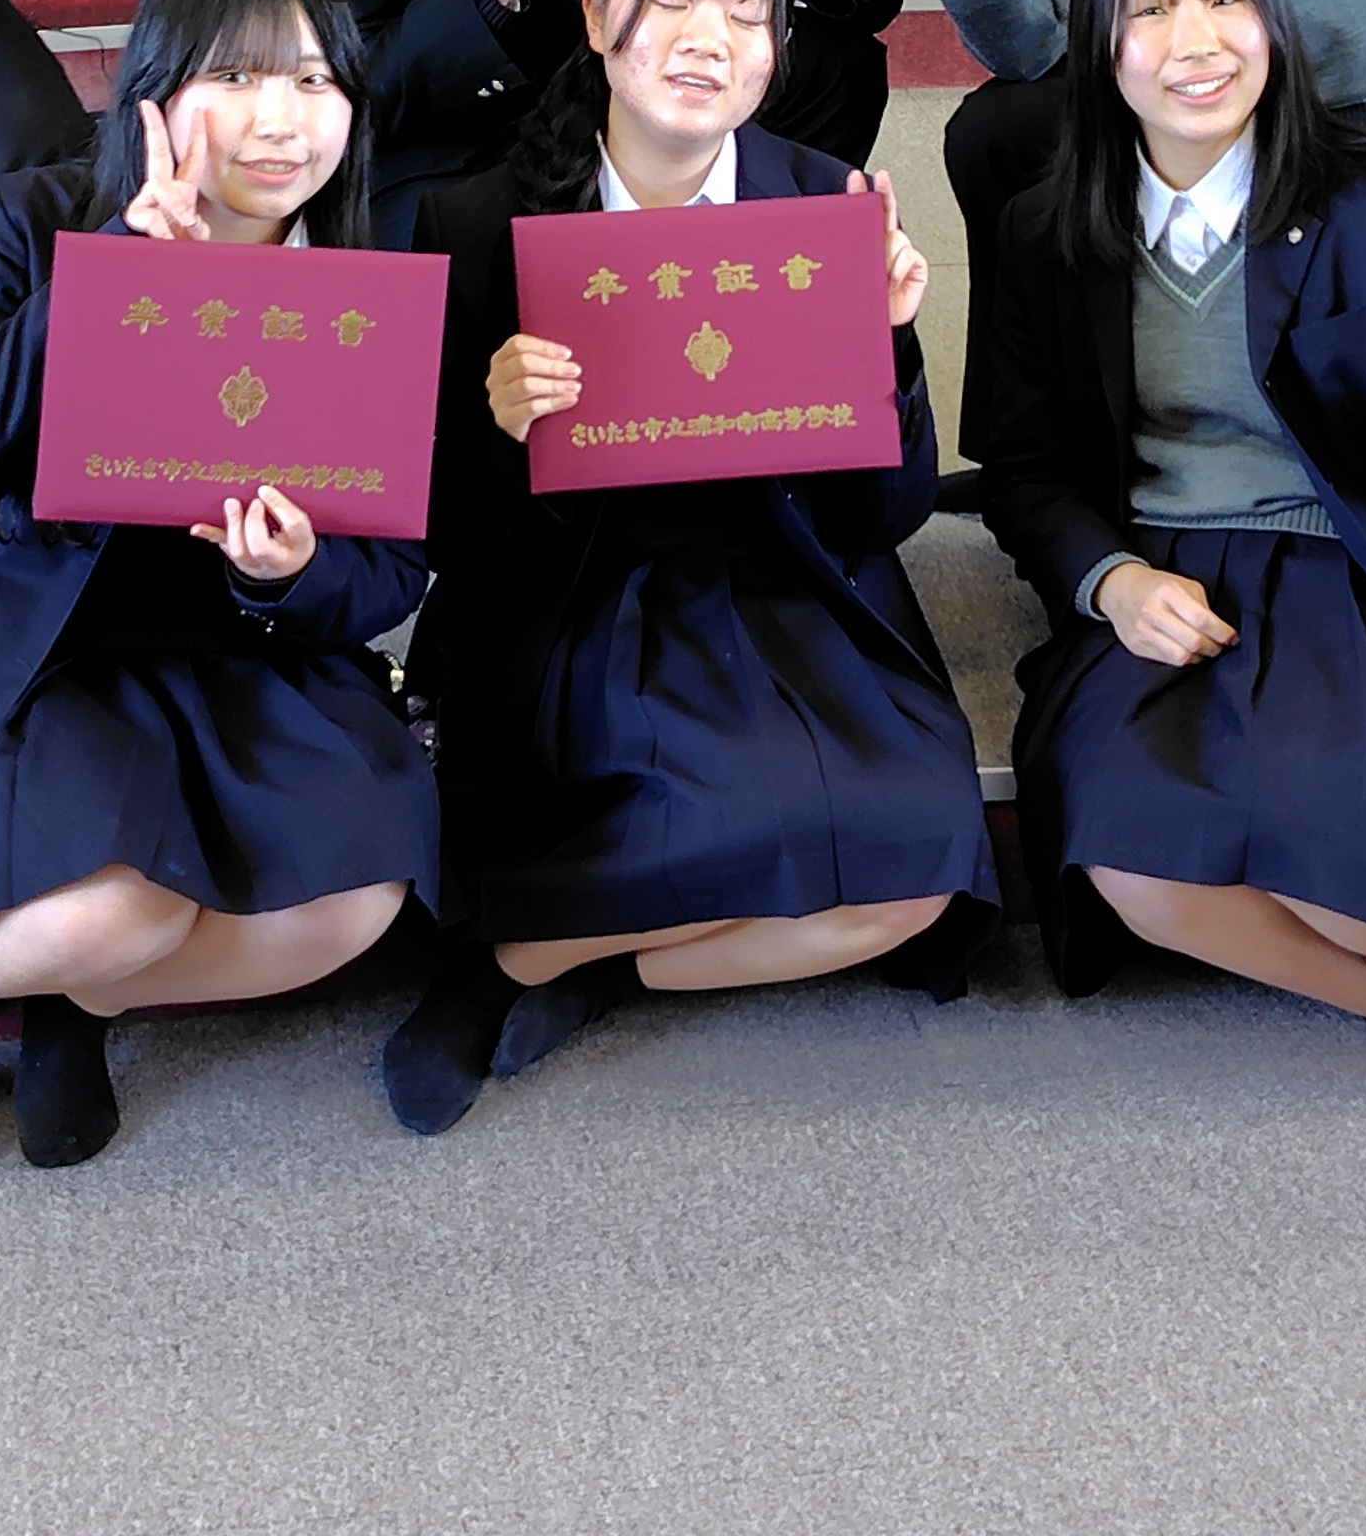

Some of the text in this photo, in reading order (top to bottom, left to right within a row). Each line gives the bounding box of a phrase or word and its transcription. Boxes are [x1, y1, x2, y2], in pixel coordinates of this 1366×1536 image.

[583, 253, 823, 306] 卒業証書
[120, 295, 378, 348] 卒業証書
